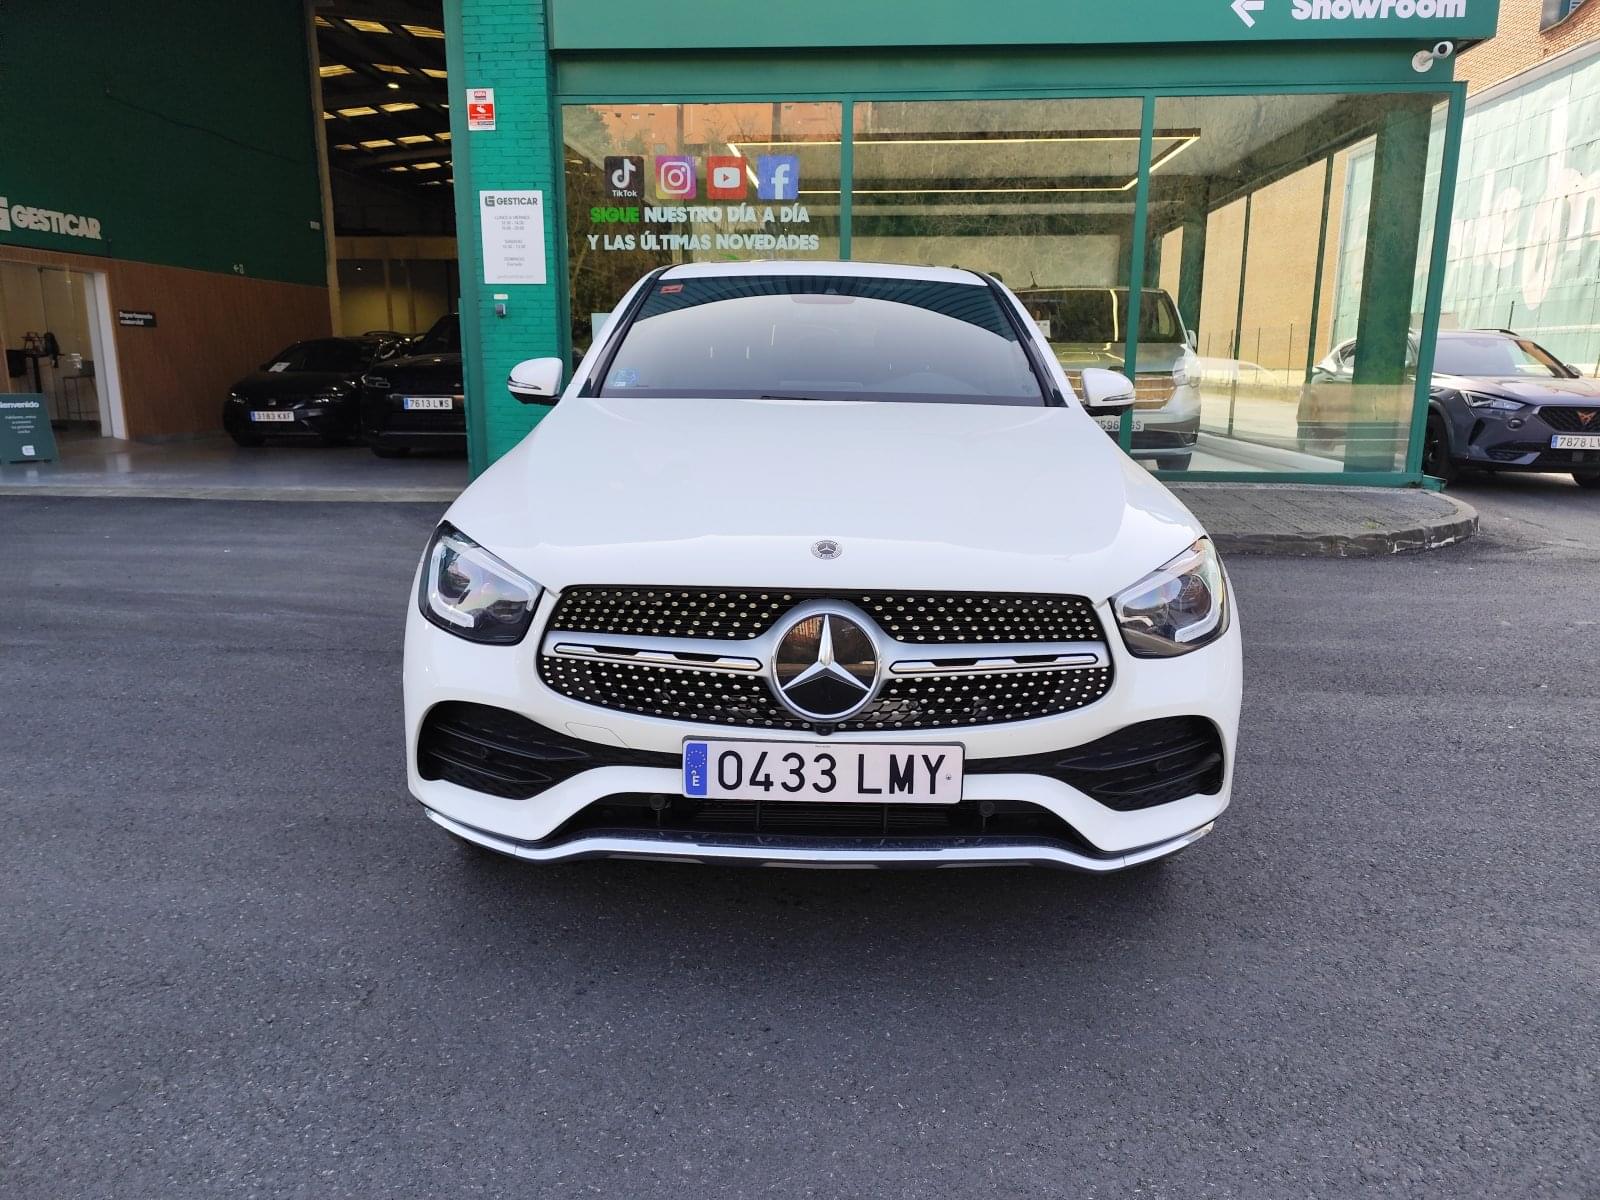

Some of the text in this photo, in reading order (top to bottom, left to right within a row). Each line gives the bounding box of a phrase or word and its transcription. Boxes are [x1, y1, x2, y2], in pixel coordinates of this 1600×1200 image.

[1292, 0, 1466, 20] Showroom
[496, 197, 538, 206] GESTICAR
[612, 189, 637, 197] TikTok
[10, 204, 102, 240] GESTICAR
[590, 203, 810, 223] SIGUE NUESTRO DÍA A DÍA
[587, 231, 819, 250] Y LAS ÚLTIMAS NOVEDADES
[410, 400, 449, 408] 7613 LWS
[1560, 437, 1586, 447] 7878
[692, 750, 946, 795] E 0433 LMY
